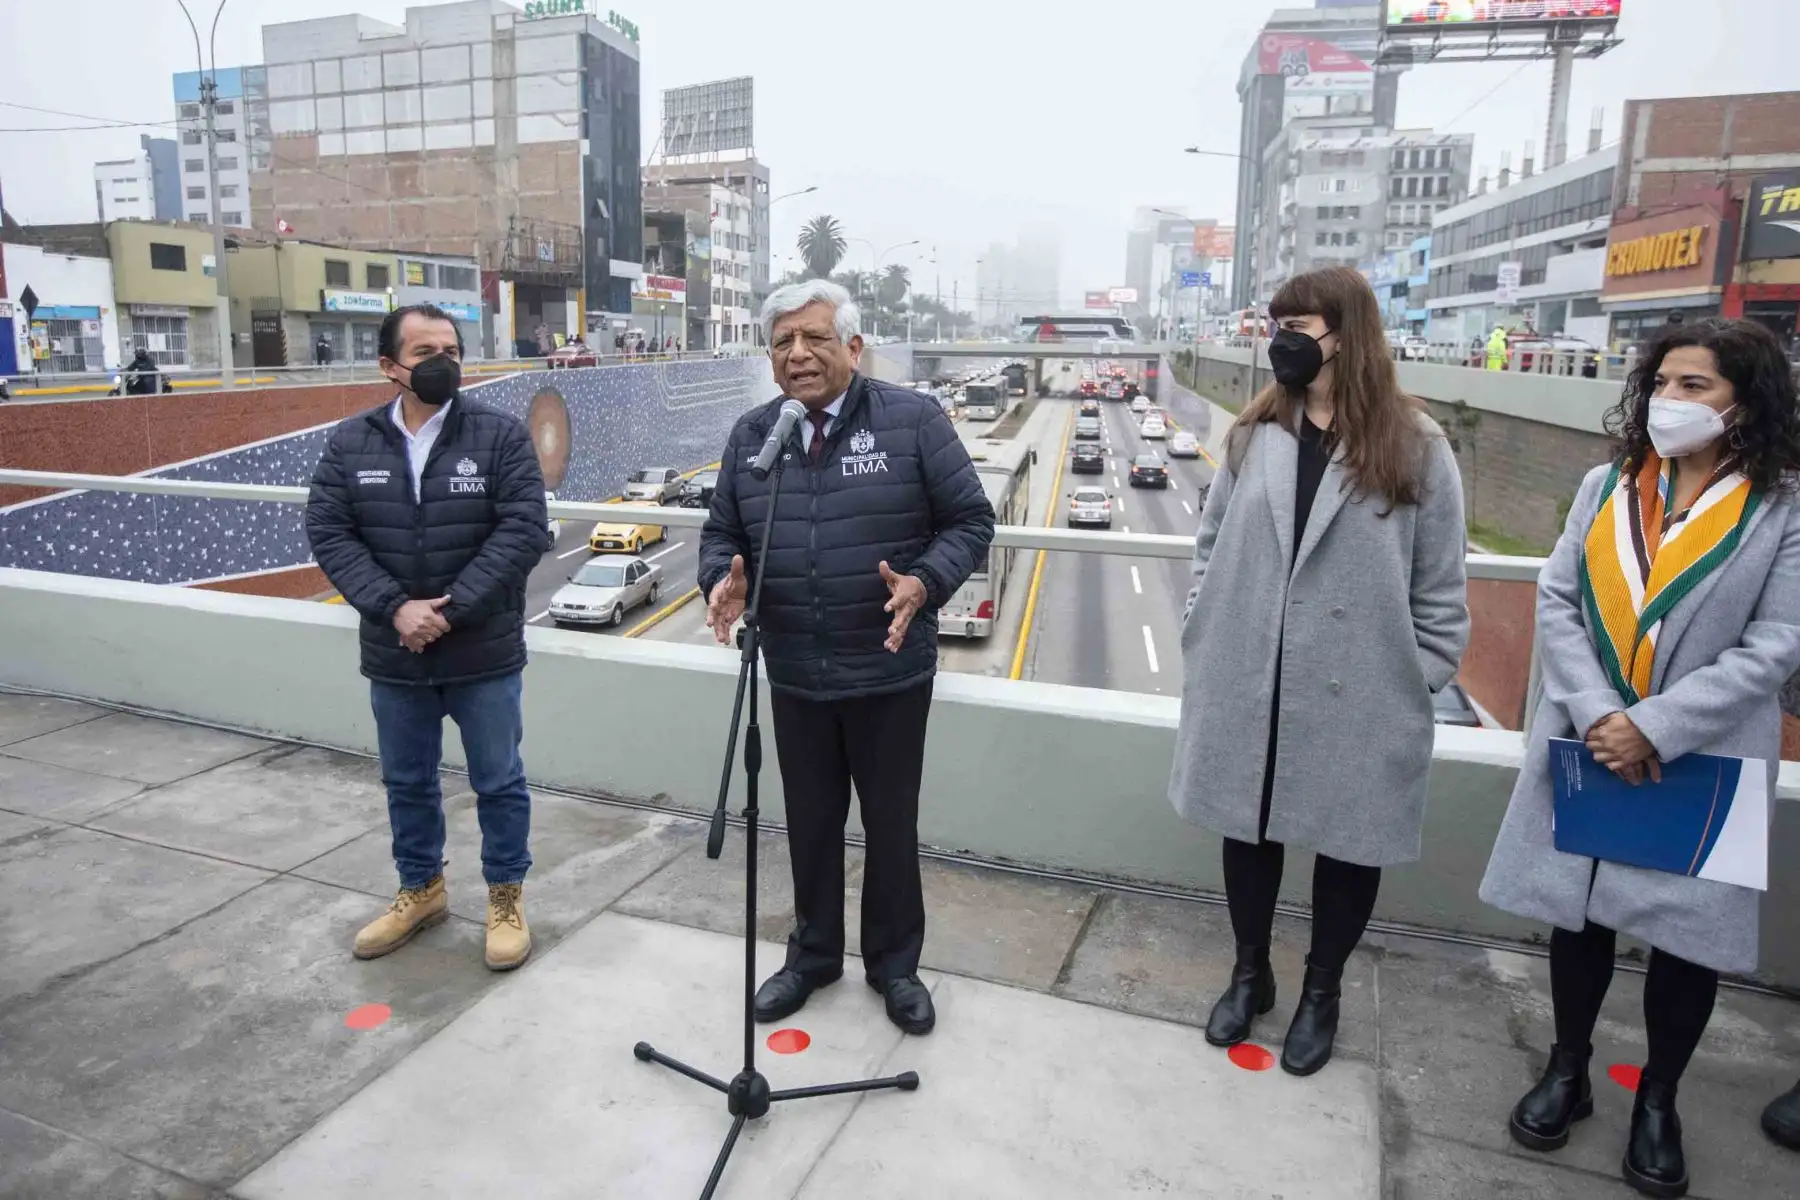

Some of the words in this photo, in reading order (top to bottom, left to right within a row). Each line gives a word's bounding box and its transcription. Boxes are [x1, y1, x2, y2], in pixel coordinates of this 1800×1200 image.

[1606, 226, 1703, 276] CROMOTEX
[842, 459, 889, 476] LIMA
[450, 482, 486, 492] LIMA
